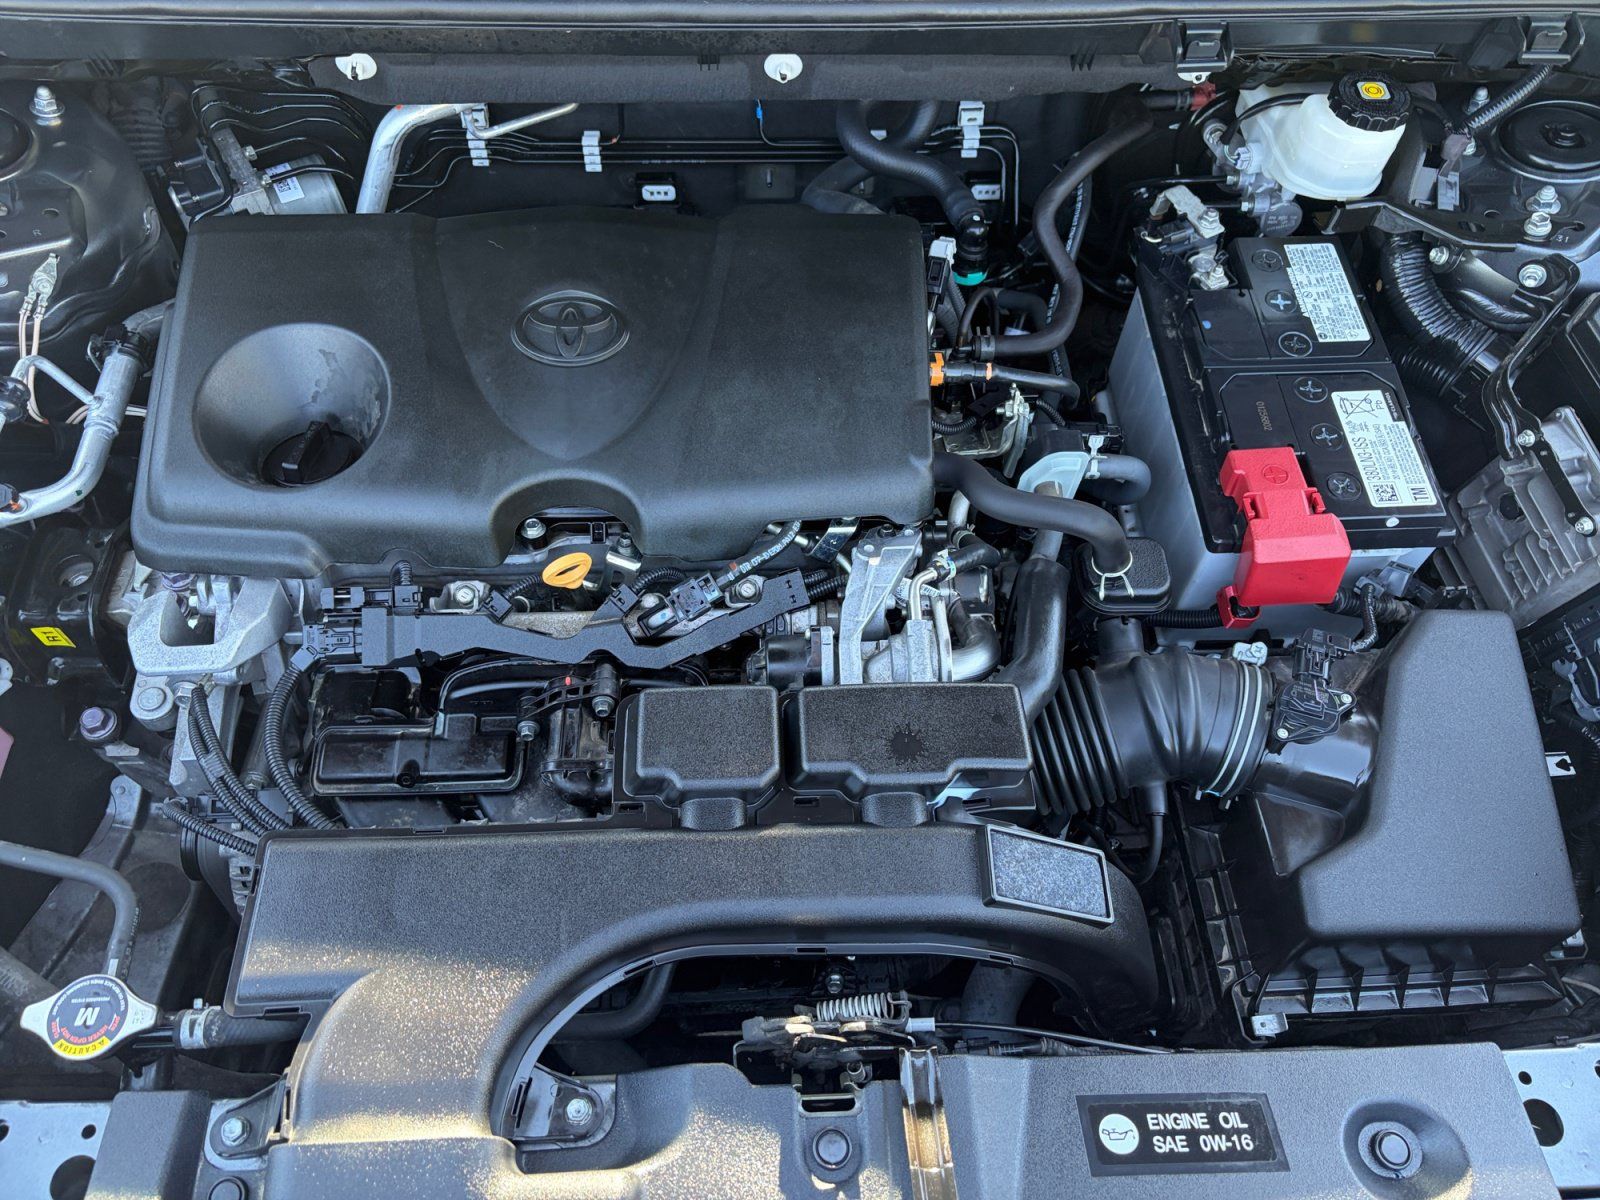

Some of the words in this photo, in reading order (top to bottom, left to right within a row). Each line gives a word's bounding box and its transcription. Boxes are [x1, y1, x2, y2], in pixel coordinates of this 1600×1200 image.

[1375, 400, 1385, 410] Pb
[1352, 437, 1381, 481] 380LN3-ISS
[1410, 487, 1429, 502] TM
[74, 1006, 100, 1027] M
[58, 1042, 97, 1055] CAUTION
[1146, 1112, 1210, 1130] ENGINE
[1218, 1112, 1248, 1129] OIL
[1153, 1135, 1190, 1153] SAE
[1199, 1134, 1254, 1151] 0W-16
